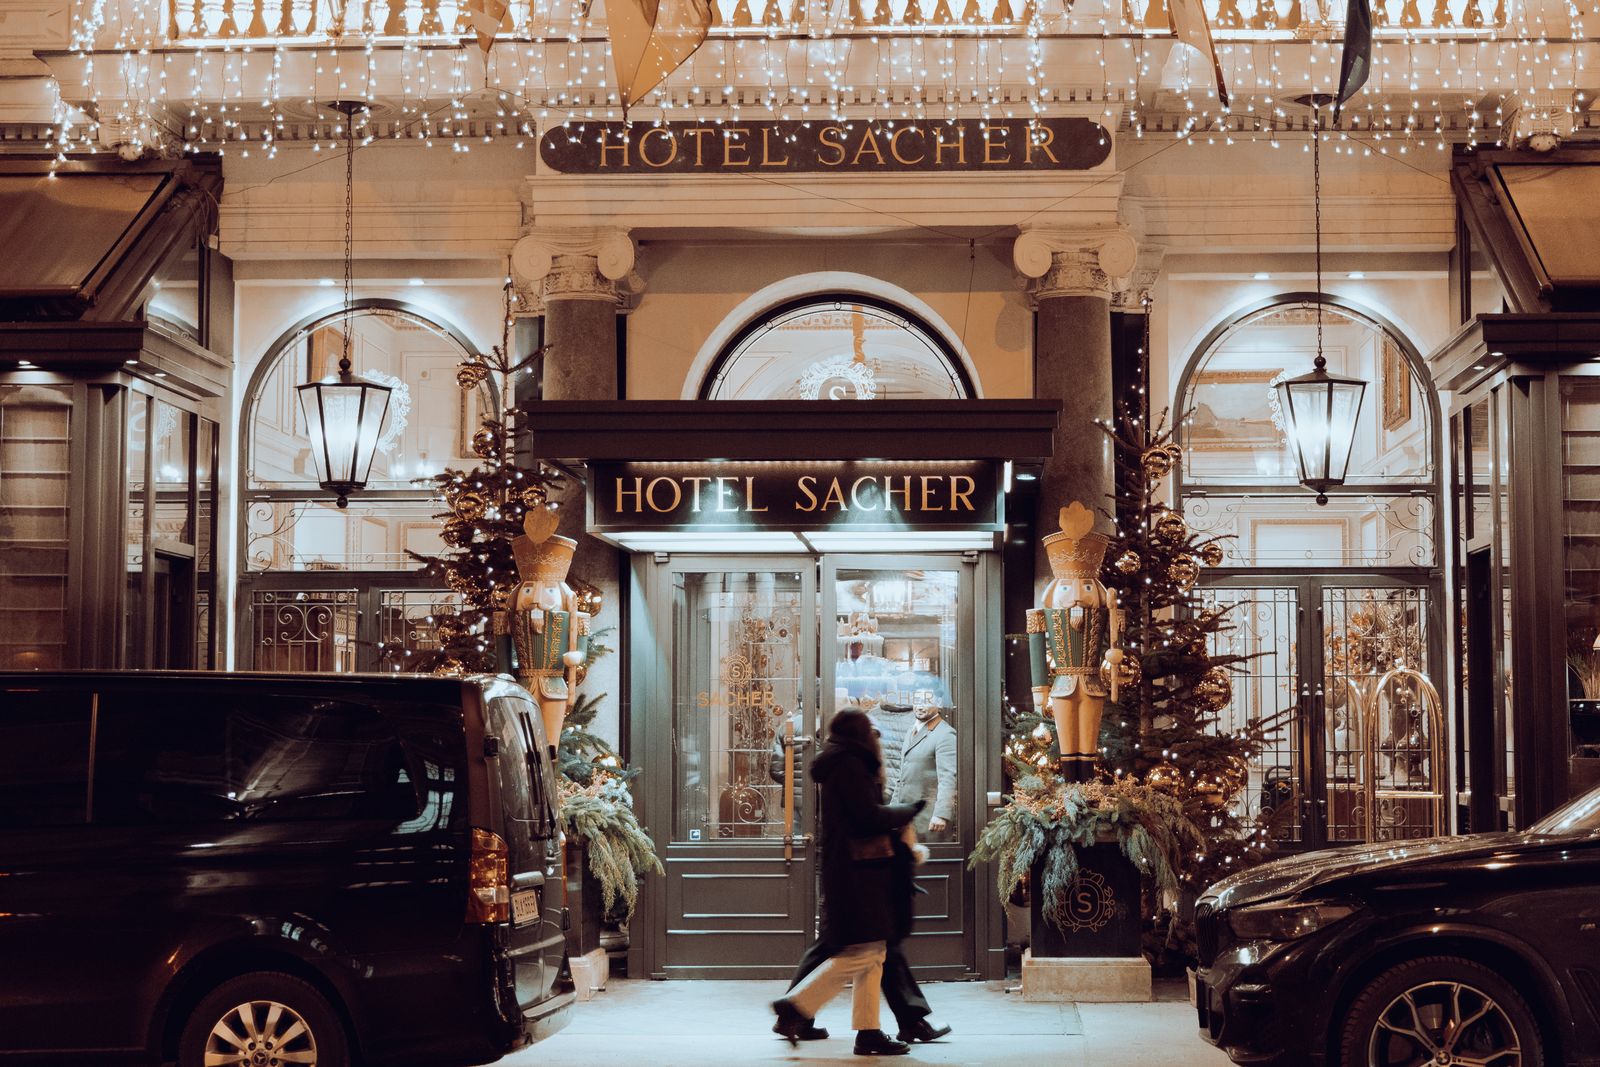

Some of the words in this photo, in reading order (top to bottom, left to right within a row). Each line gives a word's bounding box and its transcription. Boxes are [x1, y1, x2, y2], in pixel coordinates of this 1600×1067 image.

[599, 127, 789, 167] HOTEL
[817, 126, 1060, 166] SACHER
[615, 477, 769, 513] HOTEL
[795, 475, 976, 512] SACHER
[731, 665, 742, 678] S
[697, 691, 775, 707] SACHER
[862, 690, 934, 705] ACHER
[1076, 892, 1092, 913] S
